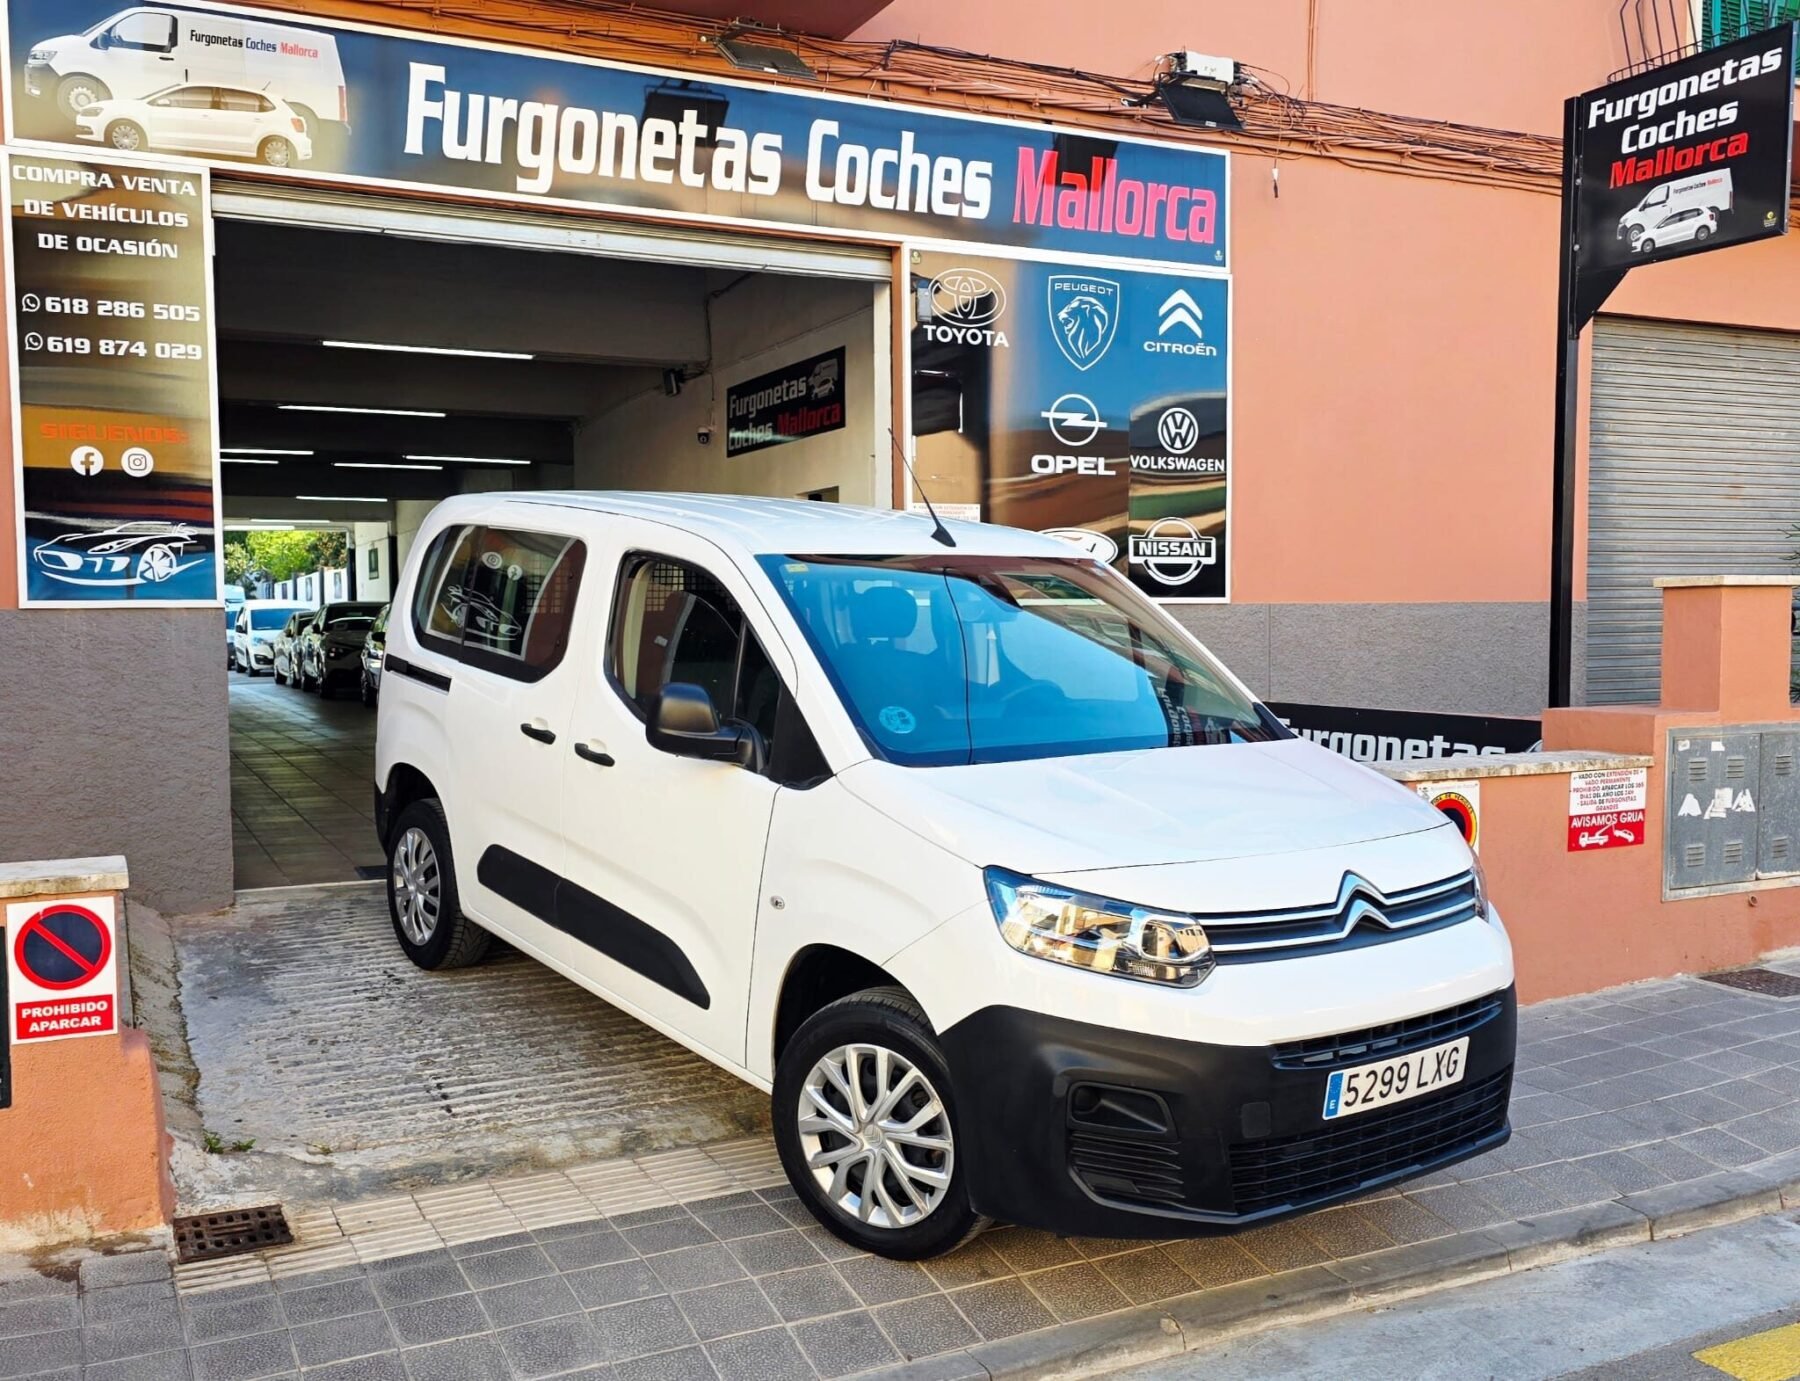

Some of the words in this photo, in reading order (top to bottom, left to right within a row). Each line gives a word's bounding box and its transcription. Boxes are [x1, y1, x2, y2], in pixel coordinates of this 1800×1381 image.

[190, 29, 243, 48] Furgonetas
[245, 37, 277, 52] Coches
[280, 42, 318, 58] Mallorca
[1588, 47, 1783, 129] Furgonetas
[1621, 101, 1739, 154] Coches
[404, 62, 783, 196] Furgonetas
[805, 118, 993, 220] Coches
[1012, 146, 1217, 244] Mallorca
[1609, 132, 1749, 189] Mallorca
[12, 164, 114, 189] COMPRA
[121, 175, 197, 196] VENTA
[24, 198, 54, 216] DE
[61, 203, 189, 227] VEHÍCULOS
[37, 233, 68, 250] DE
[76, 236, 178, 258] OCASIÓN
[1054, 282, 1114, 297] PEUGEOT
[45, 296, 89, 314] 618
[97, 300, 145, 318] 286
[153, 303, 200, 321] 505
[47, 336, 91, 354] 619
[99, 340, 147, 357] 874
[155, 343, 202, 360] 029
[923, 324, 1009, 347] TOYOTA
[1143, 341, 1217, 357] CITROËN
[729, 376, 807, 418] Furgonetas
[728, 422, 773, 450] Coches
[777, 403, 841, 436] Mallorca
[1031, 454, 1116, 476] OPEL
[1130, 454, 1225, 472] VOLKSWAGEN
[1139, 541, 1206, 557] NISSAN
[1571, 813, 1617, 828] AVISAMOS
[1620, 811, 1644, 823] GRUA
[21, 1000, 108, 1018] PROHIBIDO
[29, 1015, 102, 1033] APARCAR
[1343, 1061, 1410, 1107] 5299
[1416, 1046, 1459, 1089] LXG
[1329, 1100, 1336, 1110] E
